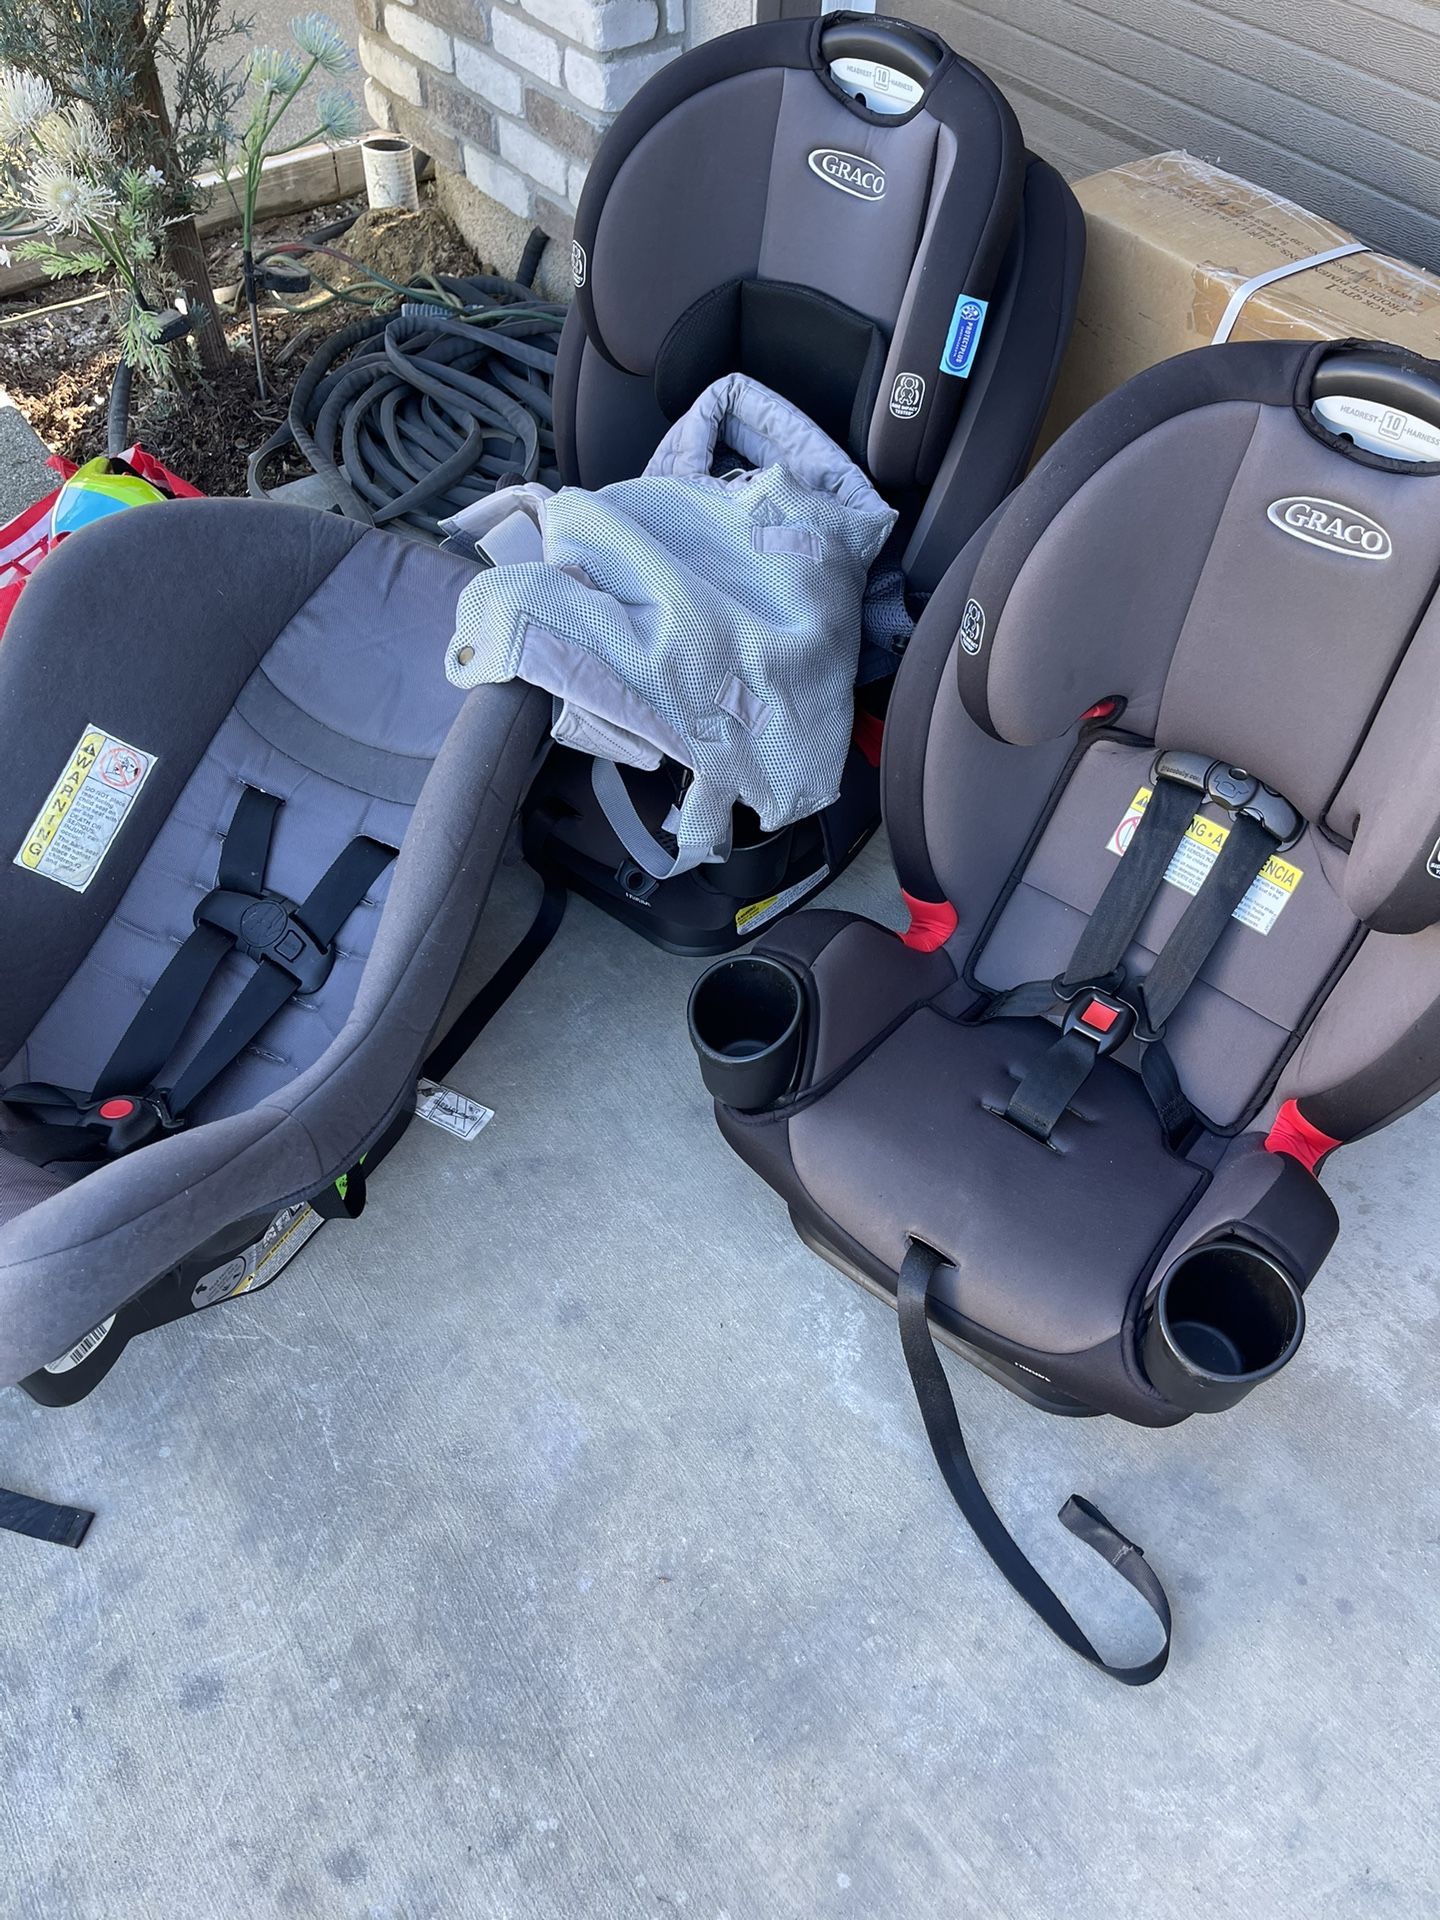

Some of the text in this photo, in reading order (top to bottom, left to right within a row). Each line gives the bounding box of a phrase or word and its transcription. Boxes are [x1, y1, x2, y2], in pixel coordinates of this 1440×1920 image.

[878, 69, 886, 82] 10
[822, 155, 884, 194] GRACO
[1347, 283, 1408, 313] PRODUCT
[1360, 299, 1397, 317] PACK
[1340, 405, 1440, 446] HEADREST 10 HARNESS
[1285, 503, 1382, 552] GRACO
[28, 754, 92, 857] WARNING
[69, 812, 91, 825] DEATH
